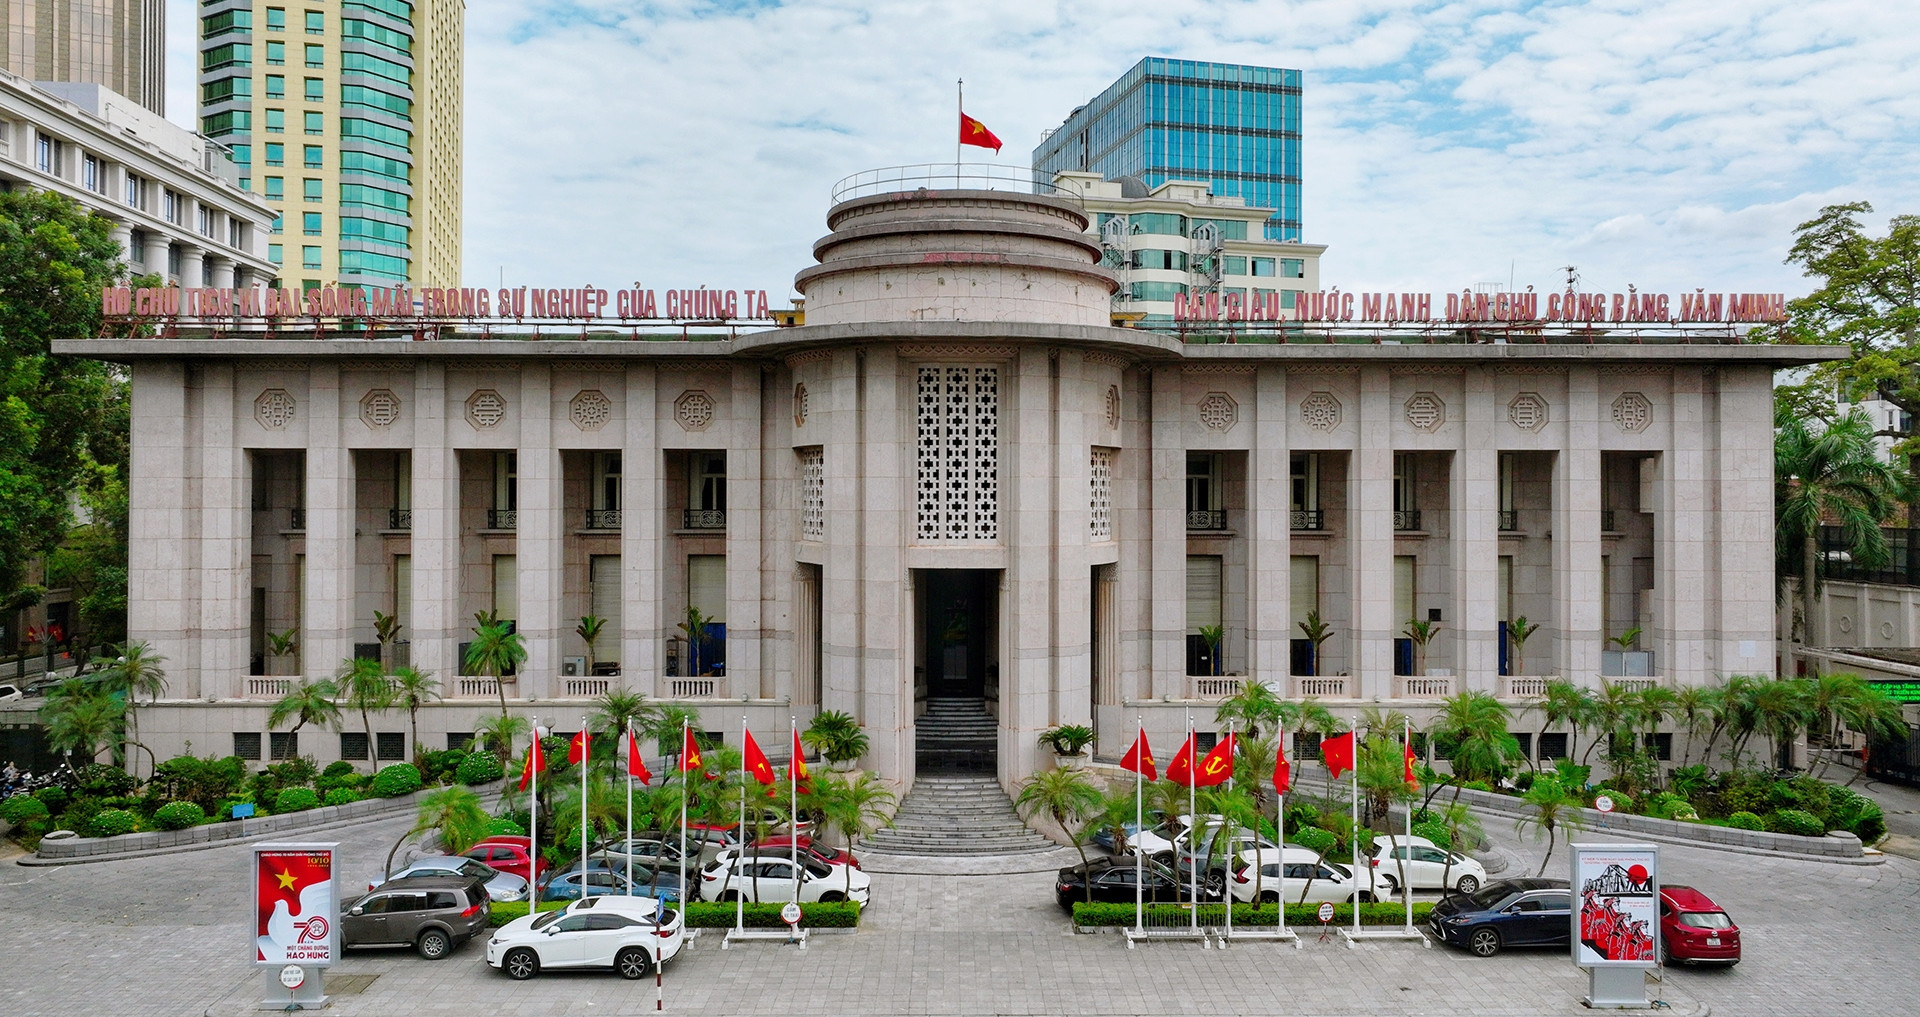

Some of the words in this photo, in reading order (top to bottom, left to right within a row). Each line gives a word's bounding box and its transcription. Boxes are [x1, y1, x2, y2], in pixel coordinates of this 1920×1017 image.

[238, 283, 261, 317] VĨ
[307, 281, 367, 317] SỐNG
[372, 283, 414, 317] MÃI
[421, 288, 490, 317] TRONG
[498, 286, 526, 323] SỰ
[531, 284, 608, 322] NGHIỆP
[617, 281, 657, 318] CỦA
[666, 284, 737, 318] CHÚNG
[744, 290, 770, 318] TA
[1174, 287, 1219, 321] DÂN
[1227, 287, 1286, 323] GIÀU,
[1295, 286, 1354, 321] NƯỚC
[1446, 288, 1489, 321] DÂN
[1548, 289, 1606, 321] CÔNG
[1680, 288, 1723, 322] VĂN
[1729, 293, 1785, 322] MINH
